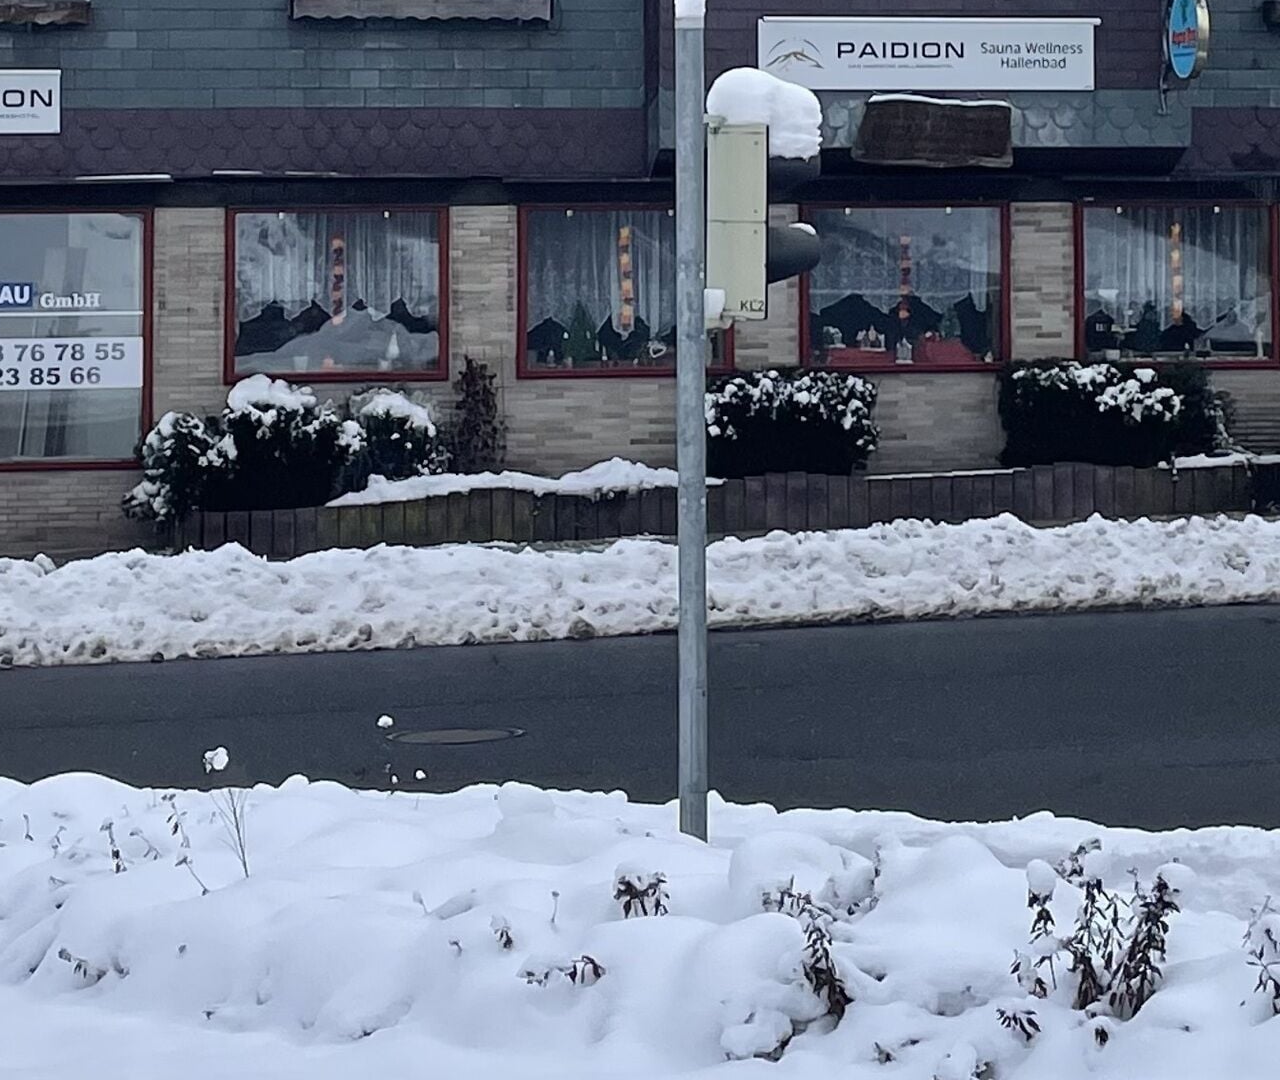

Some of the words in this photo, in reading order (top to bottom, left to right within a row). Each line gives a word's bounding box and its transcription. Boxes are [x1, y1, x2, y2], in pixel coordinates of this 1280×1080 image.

[837, 41, 966, 59] PAIDION
[980, 41, 1021, 55] Sauna
[1025, 41, 1084, 55] Wellness
[1000, 57, 1067, 70] Hallenbad
[39, 292, 102, 308] GmbH
[740, 299, 764, 312] KL2
[14, 343, 46, 362] 76
[54, 343, 85, 362] 78
[94, 342, 126, 361] 55
[29, 367, 61, 386] 85
[70, 366, 102, 385] 66
